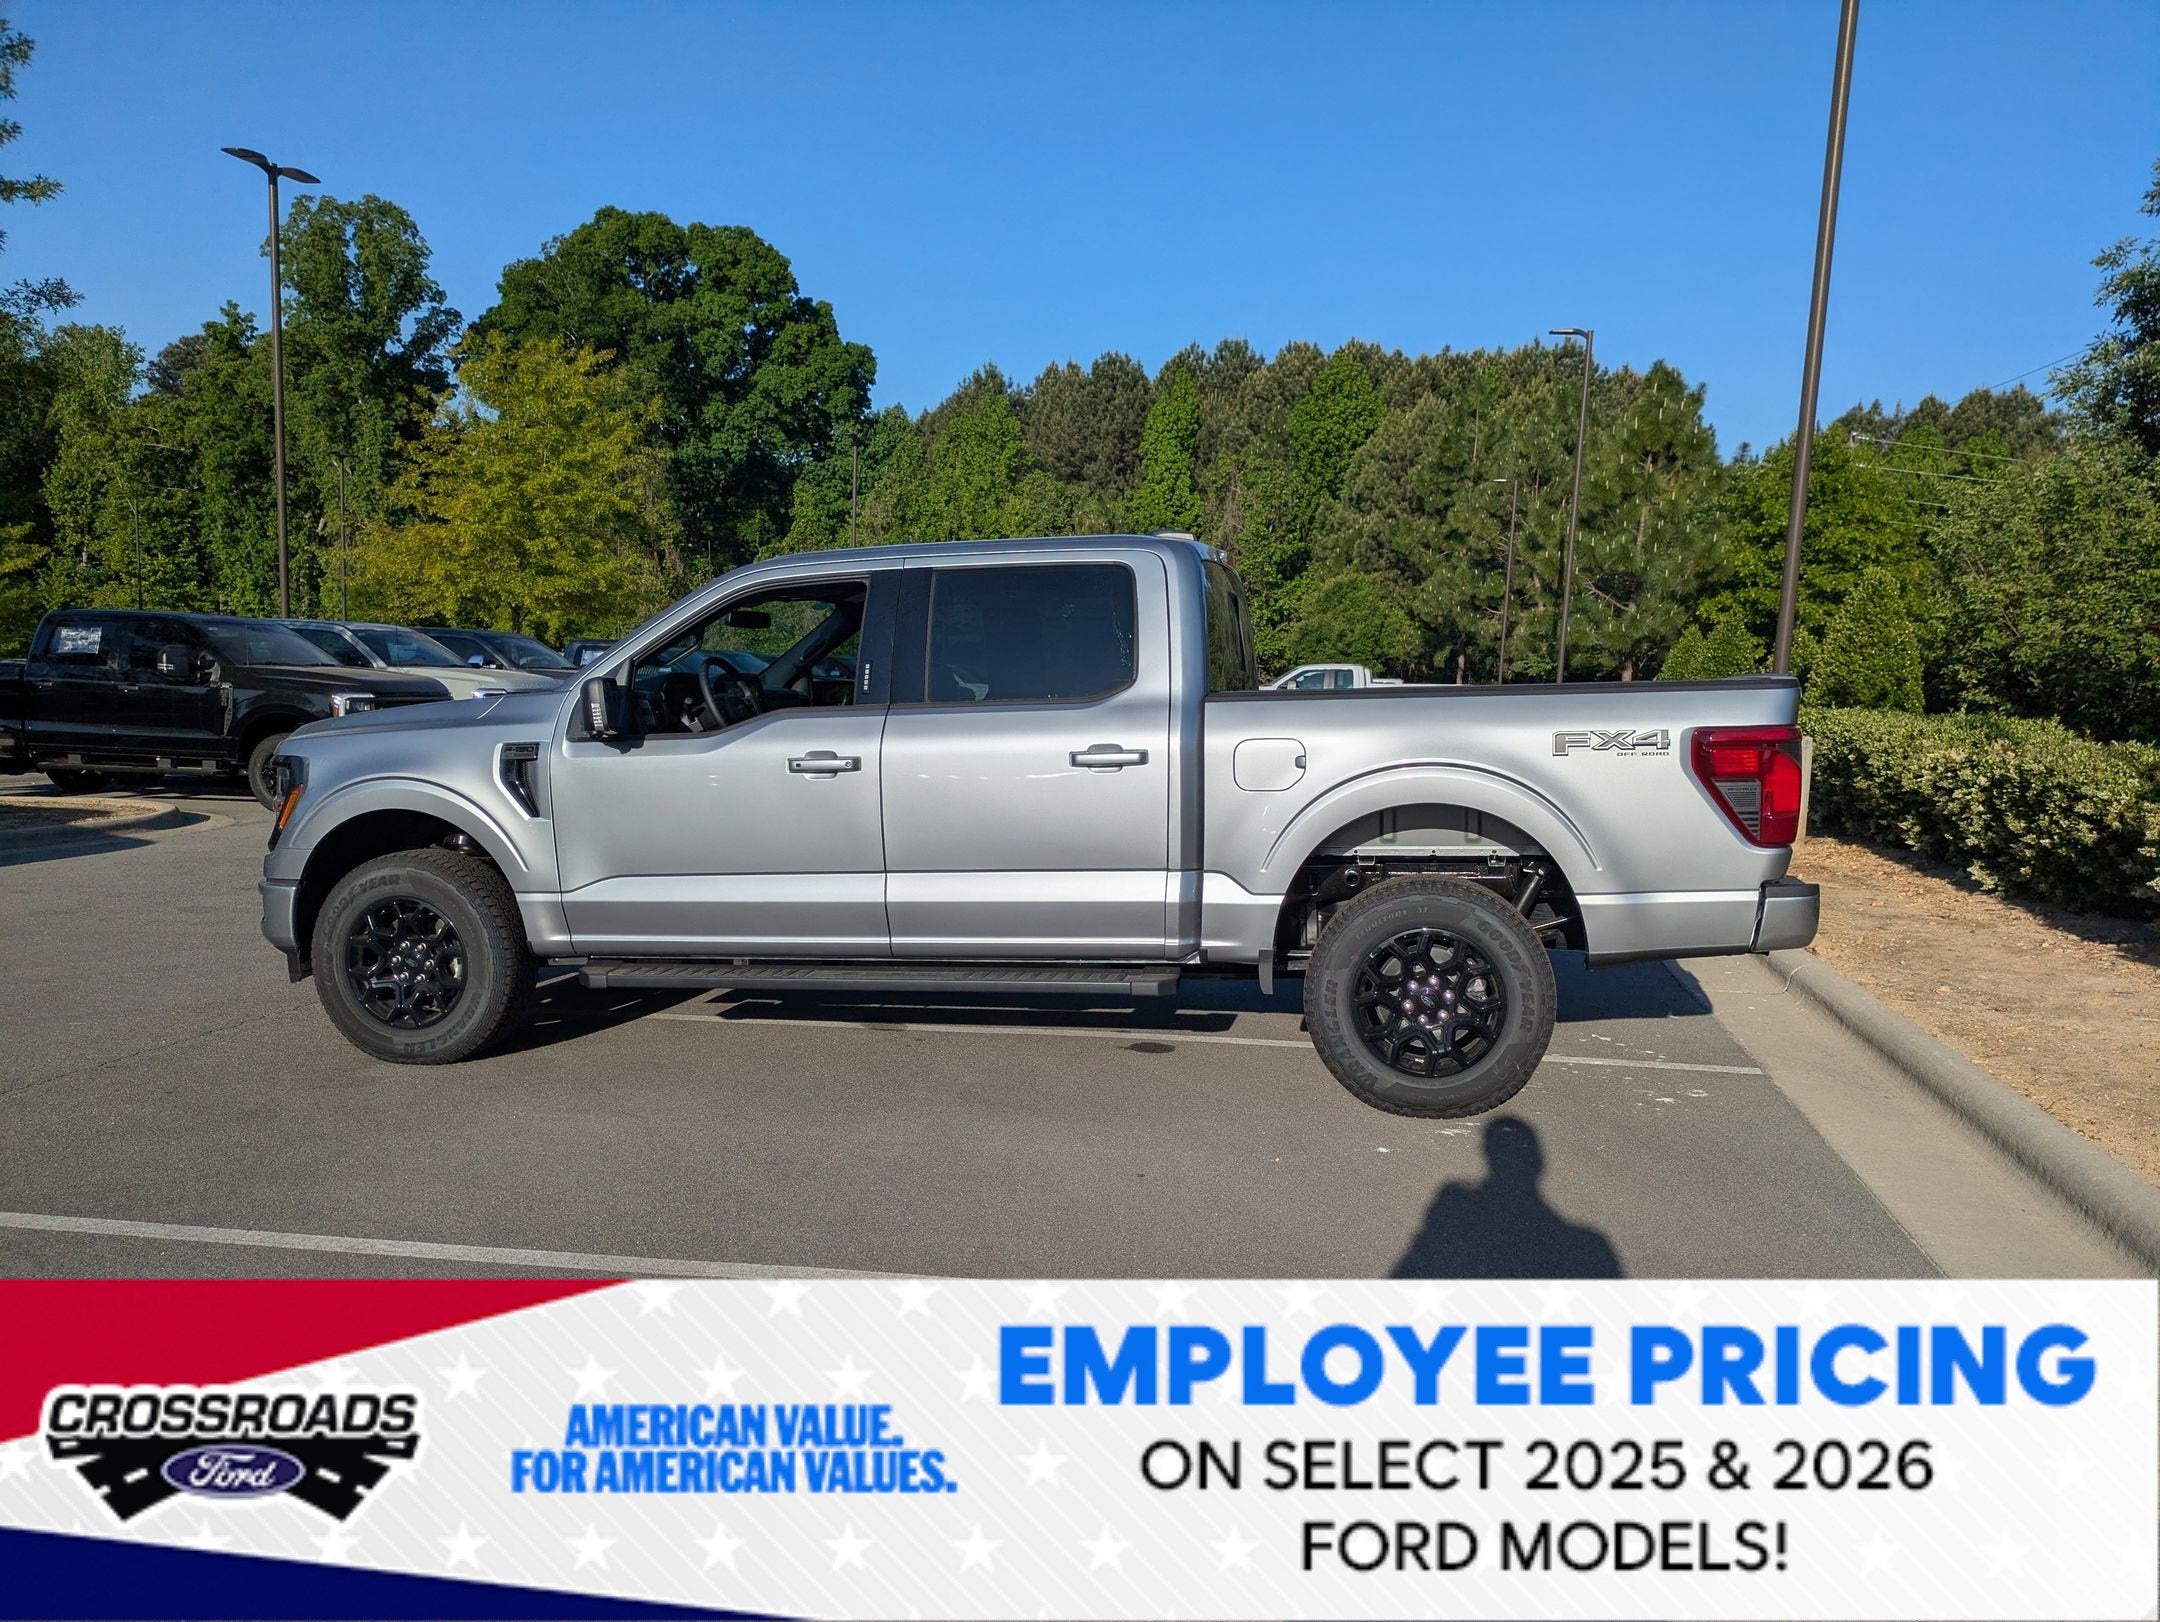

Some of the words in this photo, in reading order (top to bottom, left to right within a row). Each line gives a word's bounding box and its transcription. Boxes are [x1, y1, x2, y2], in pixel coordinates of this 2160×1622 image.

[1552, 729, 1670, 756] FX4
[1477, 919, 1534, 1034] GOODYEAR
[1324, 979, 1381, 1091] WRANGLER
